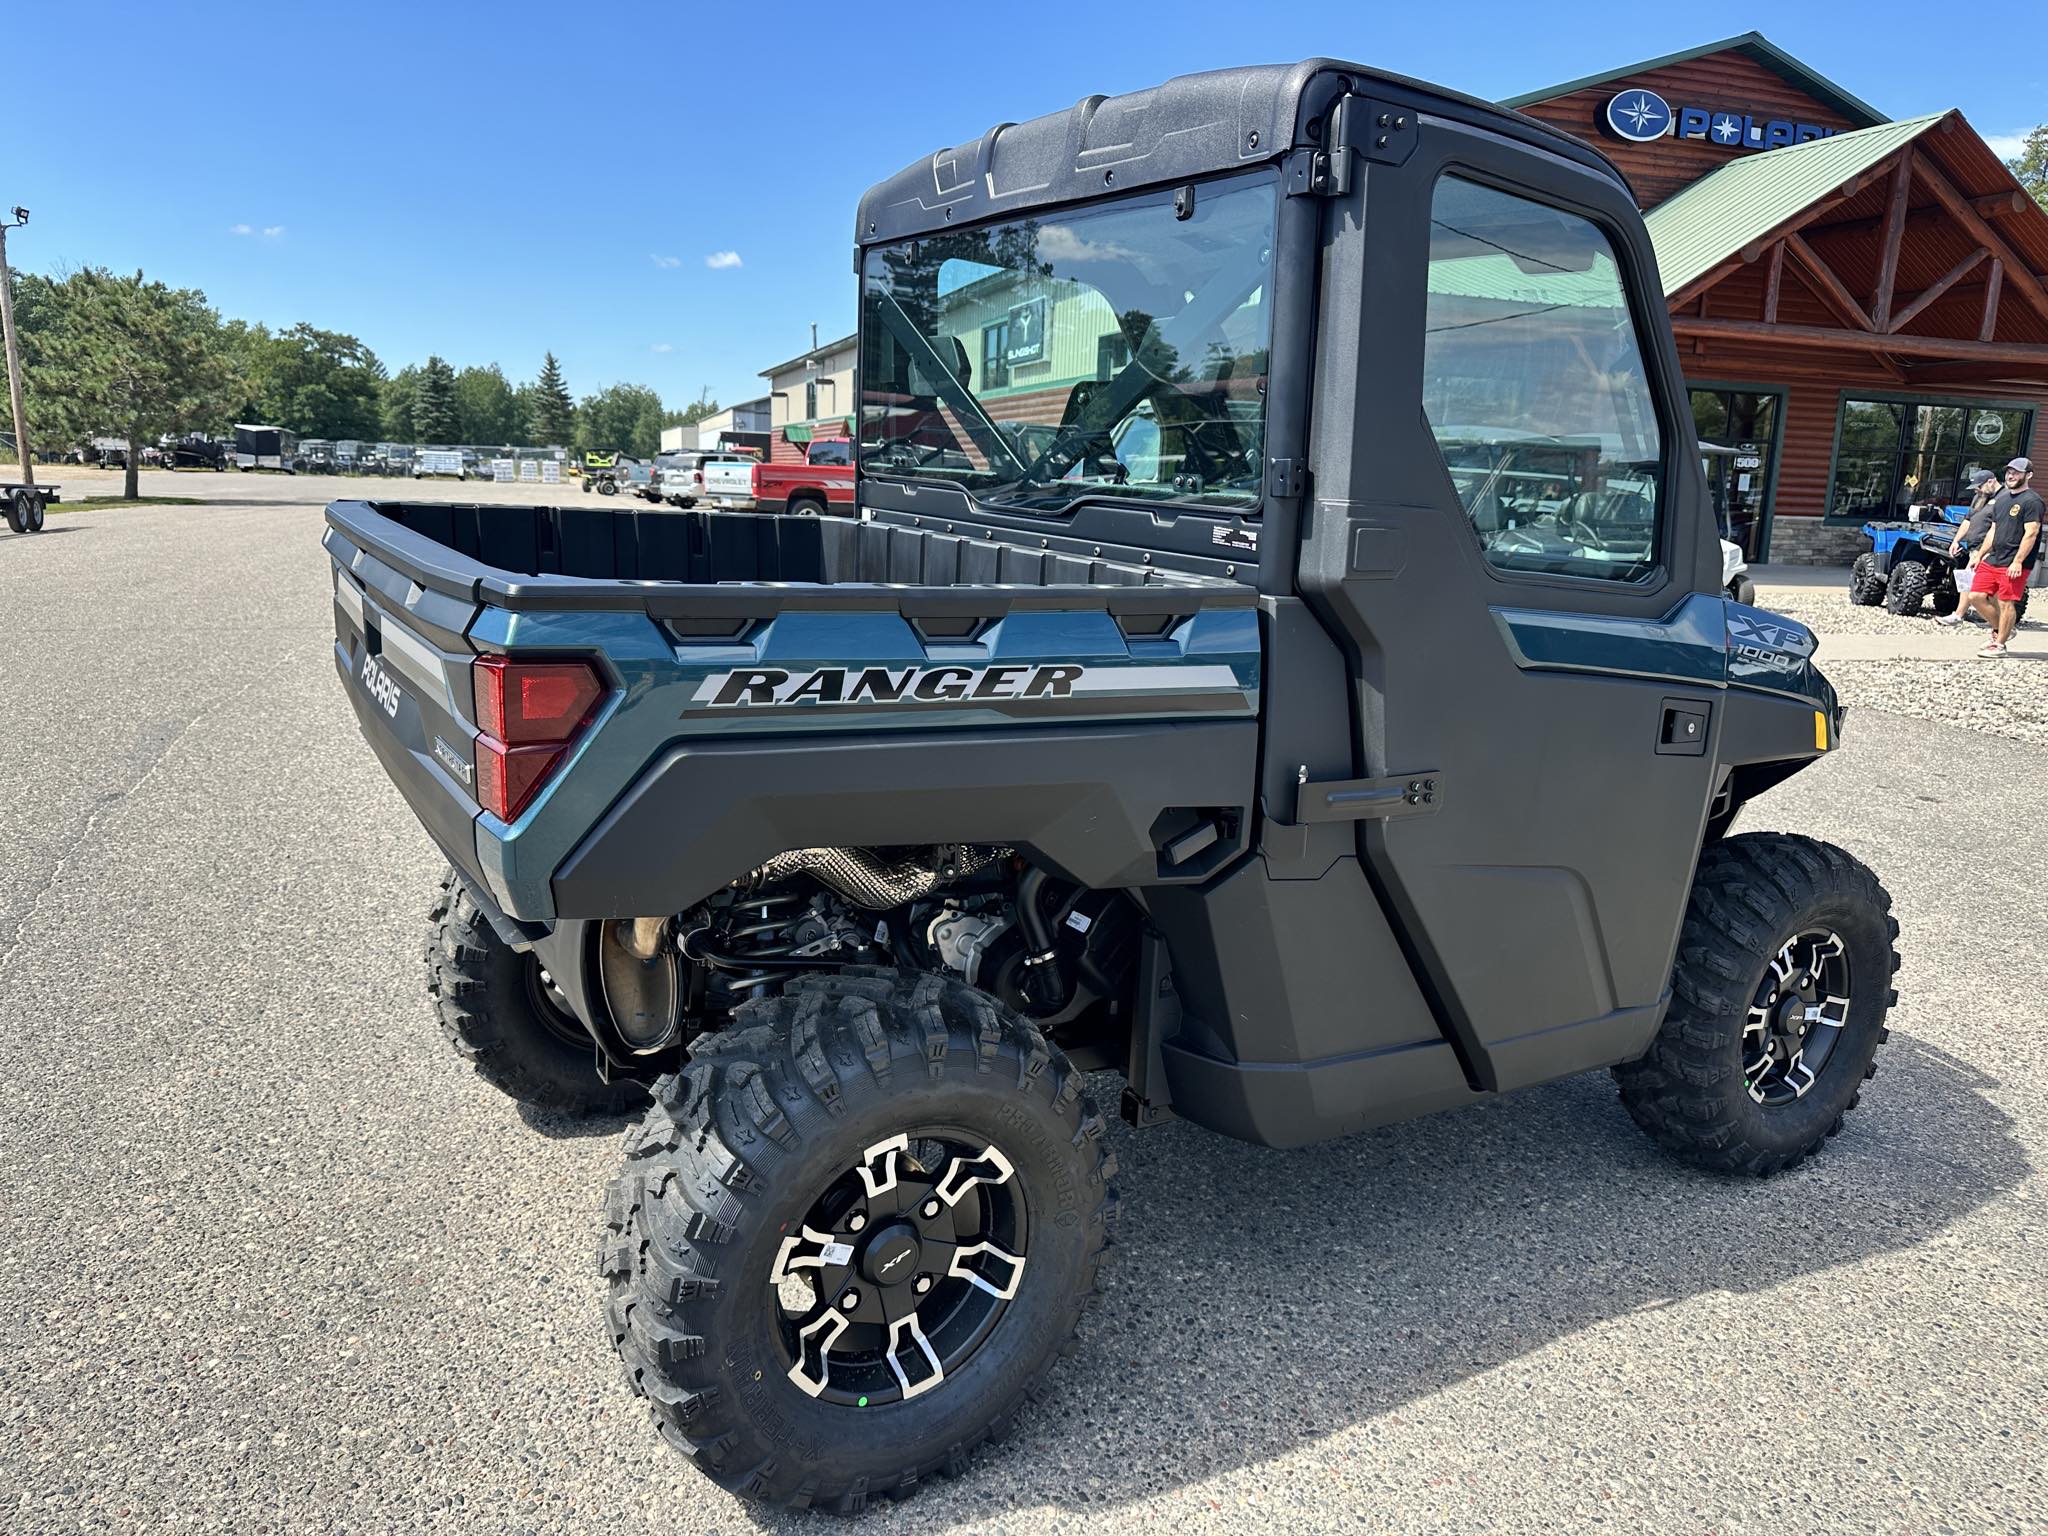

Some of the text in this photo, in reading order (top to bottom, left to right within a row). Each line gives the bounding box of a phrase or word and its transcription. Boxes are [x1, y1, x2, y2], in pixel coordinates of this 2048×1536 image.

[1731, 614, 1806, 651] XP
[1737, 643, 1790, 667] 1000
[360, 653, 401, 719] POLARIS
[707, 664, 1084, 707] RANGER
[880, 1249, 911, 1273] XP
